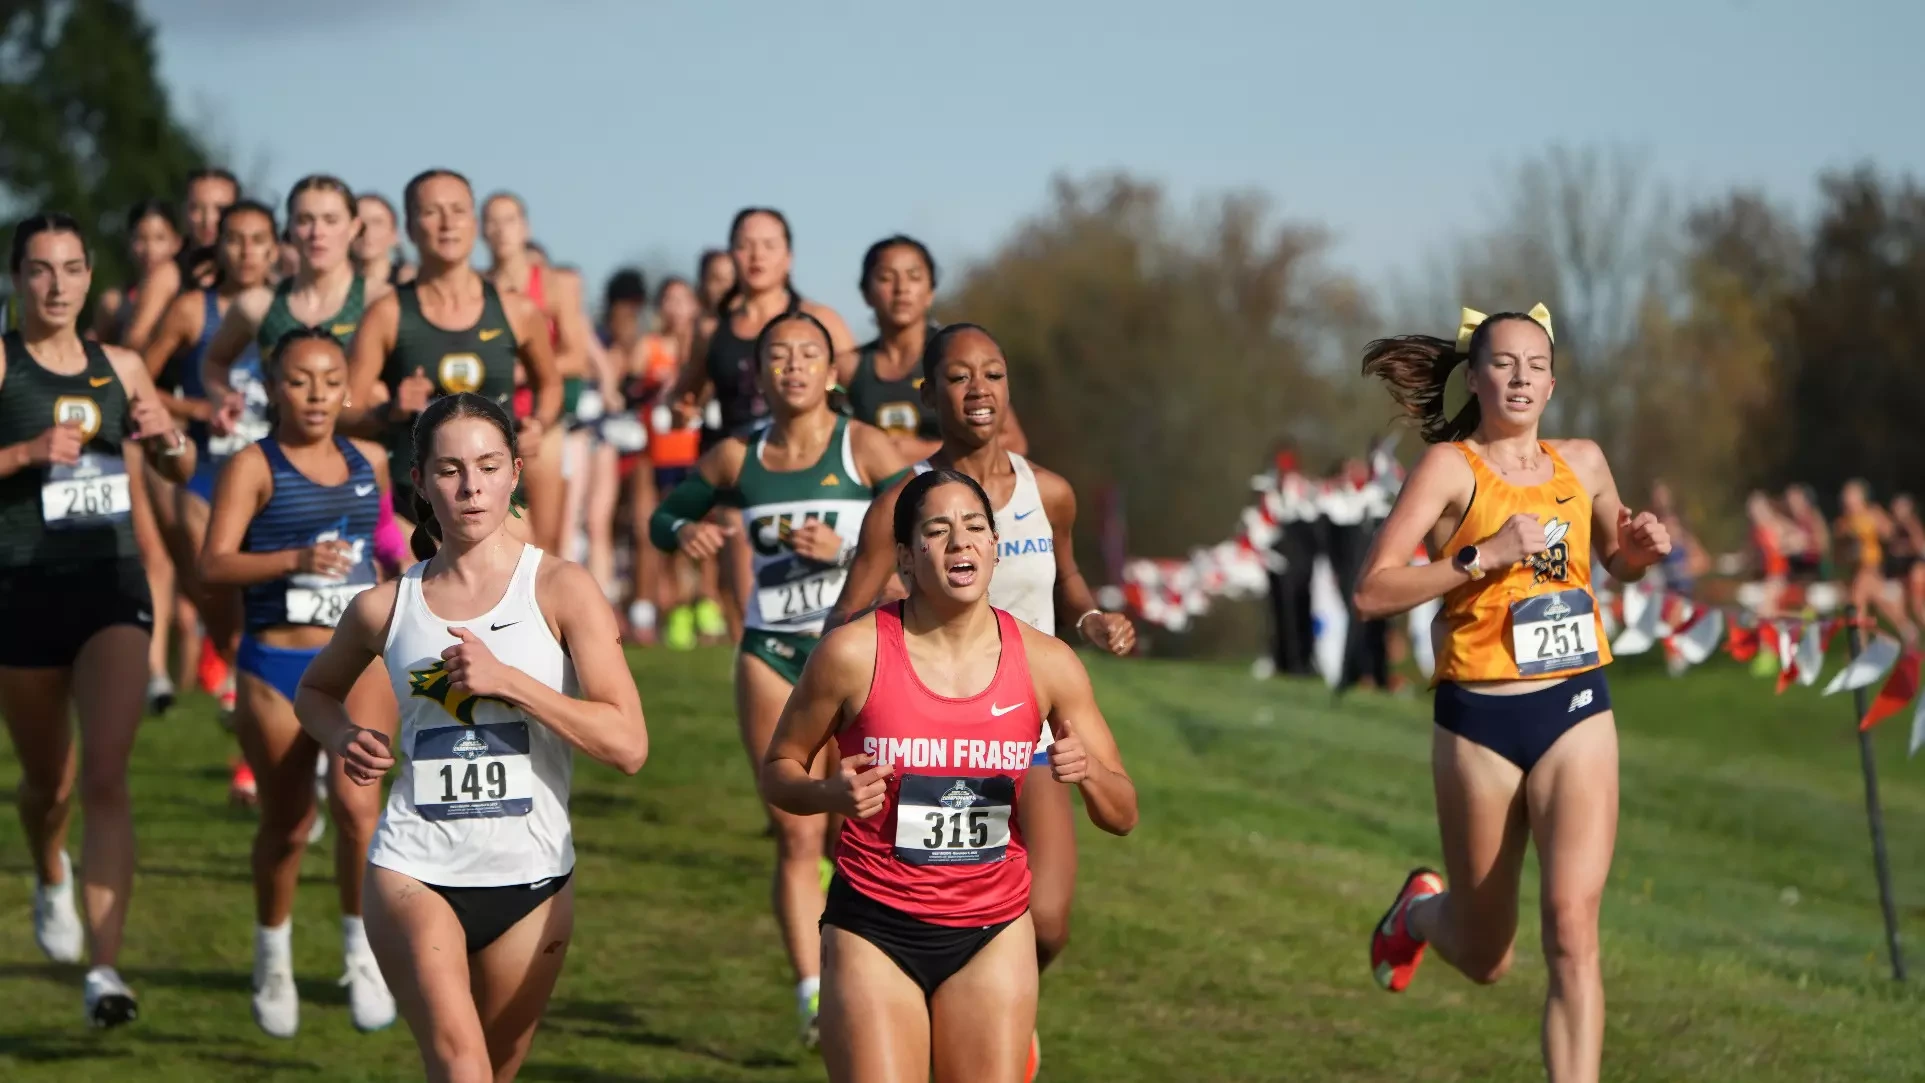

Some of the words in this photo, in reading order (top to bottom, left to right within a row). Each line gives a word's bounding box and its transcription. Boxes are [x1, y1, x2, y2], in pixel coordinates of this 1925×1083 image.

[64, 483, 113, 515] 268
[310, 590, 347, 624] 28
[779, 578, 825, 615] 217
[1534, 622, 1584, 660] 251
[863, 737, 947, 768] SIMON
[953, 739, 1033, 770] FRASER
[439, 761, 507, 802] 149
[923, 811, 989, 849] 315
